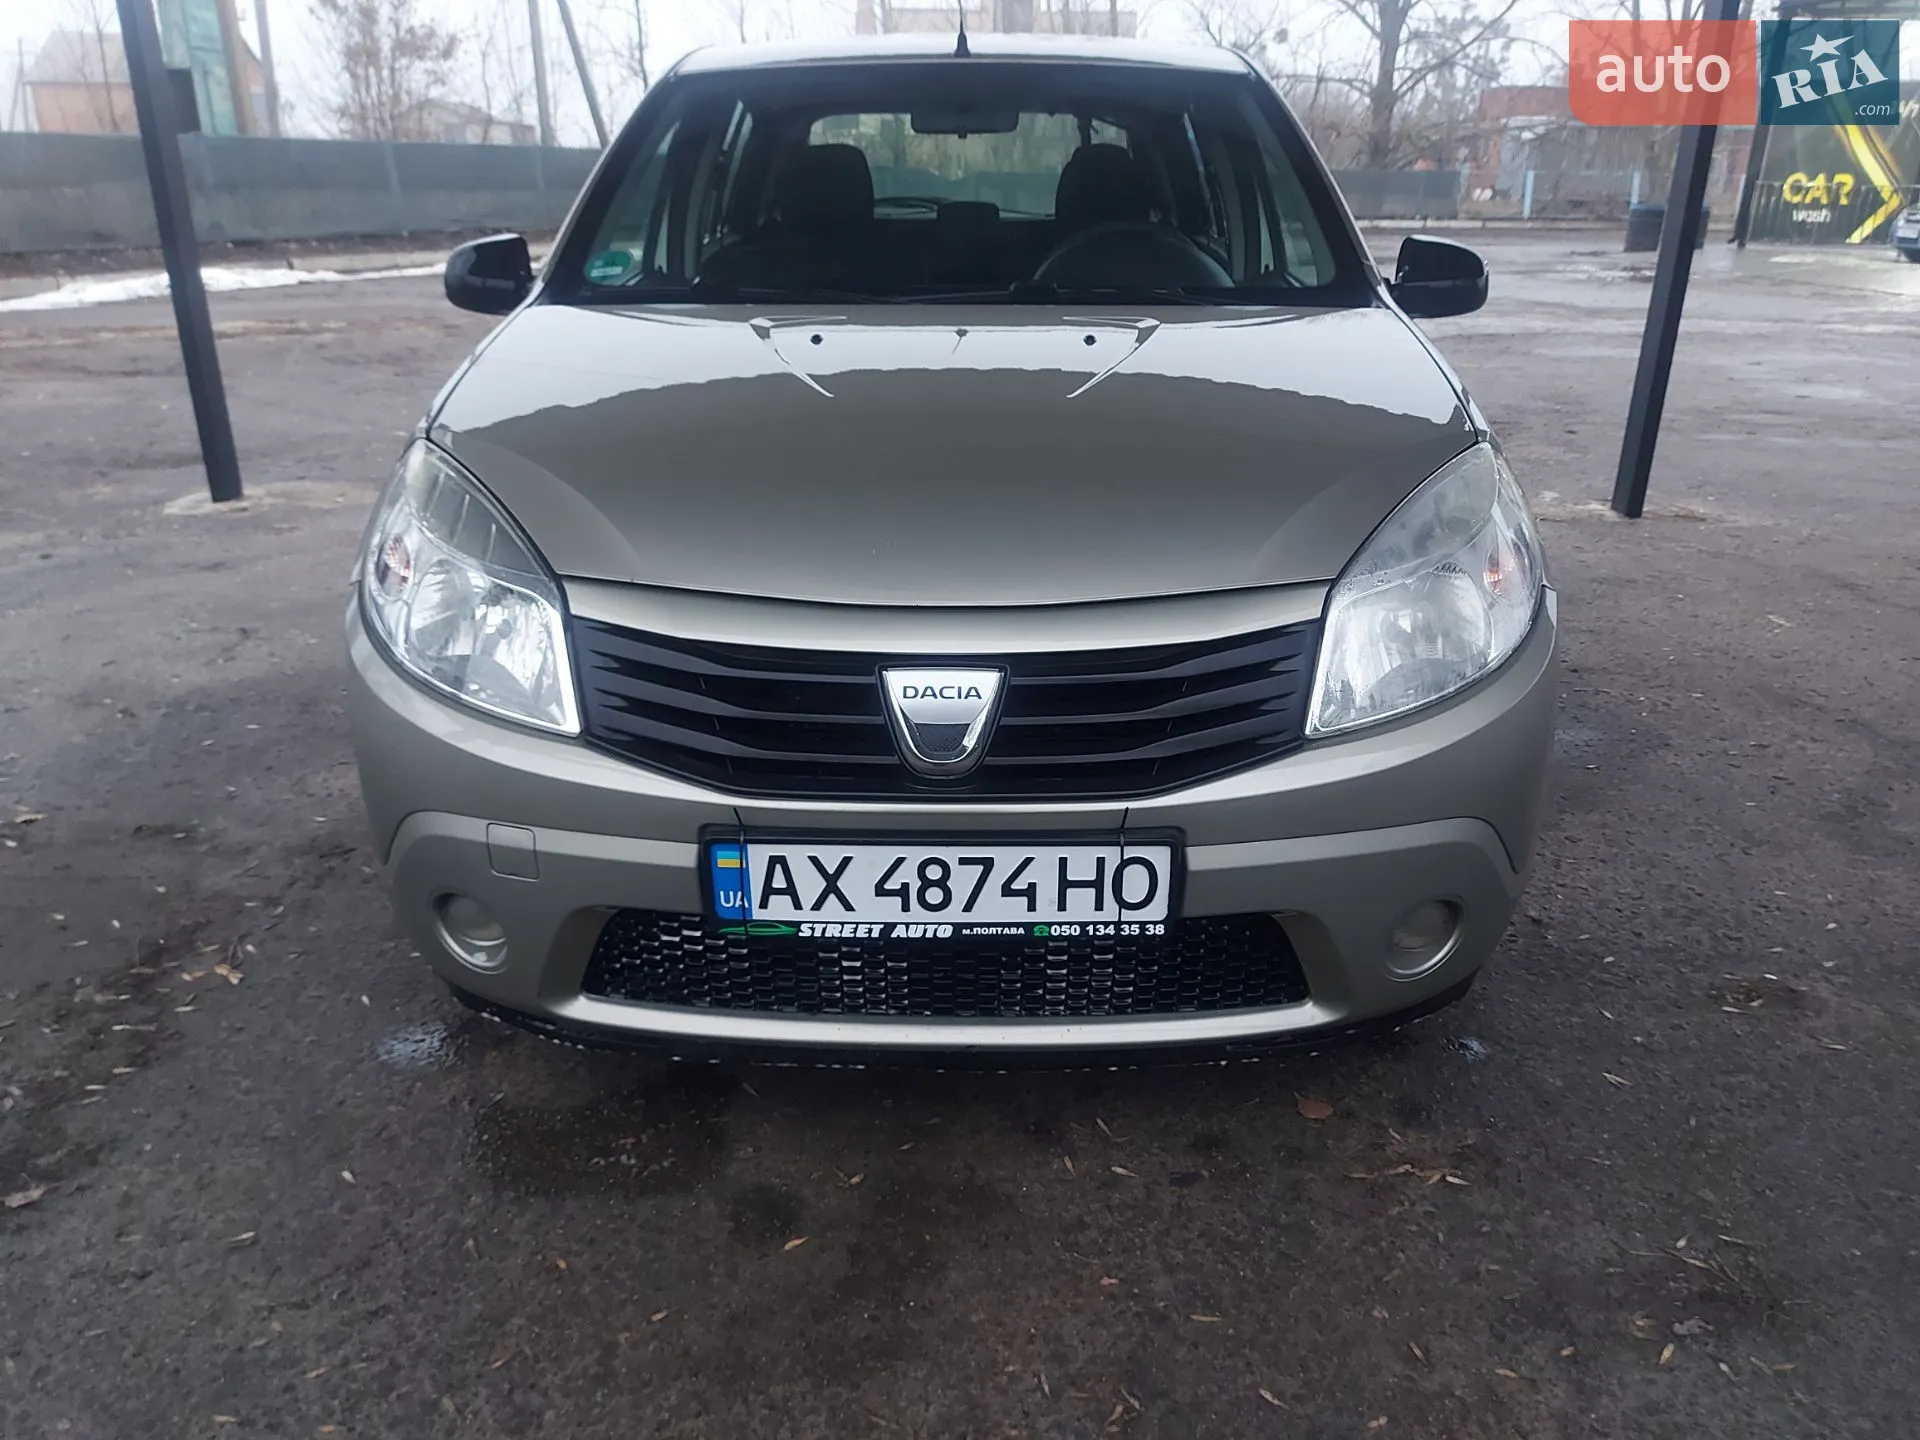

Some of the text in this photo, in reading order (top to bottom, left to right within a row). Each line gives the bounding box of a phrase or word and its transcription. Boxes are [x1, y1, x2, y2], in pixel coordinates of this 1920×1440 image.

[1783, 172, 1855, 205] CAR
[903, 686, 982, 699] DACIA
[758, 855, 1158, 913] AX 4874 HO
[720, 890, 749, 908] UA
[798, 923, 953, 938] STREET AUTO
[1050, 924, 1165, 936] 050 134 35 38
